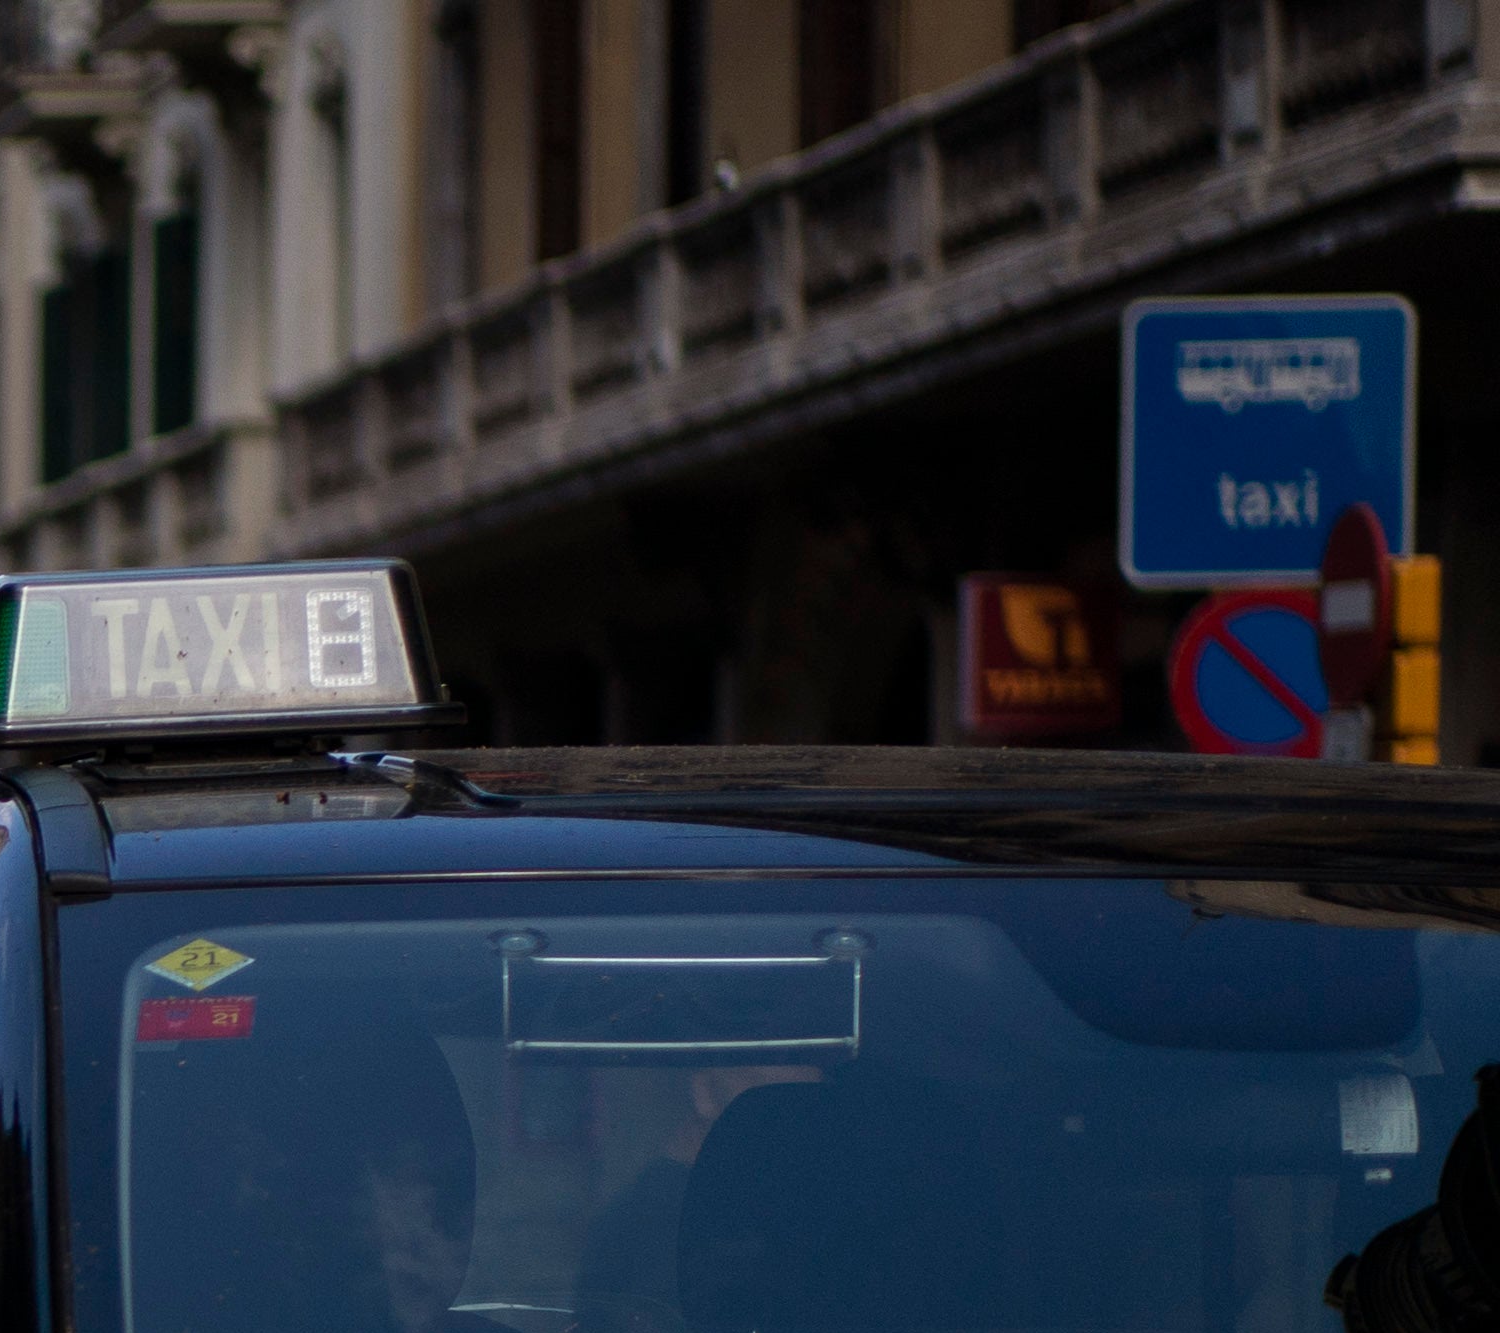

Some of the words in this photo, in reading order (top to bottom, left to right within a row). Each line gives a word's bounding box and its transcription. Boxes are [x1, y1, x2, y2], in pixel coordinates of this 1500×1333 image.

[1217, 471, 1319, 527] taxi
[91, 592, 283, 698] TAXI
[181, 951, 221, 968] 21
[211, 1012, 239, 1025] 21
